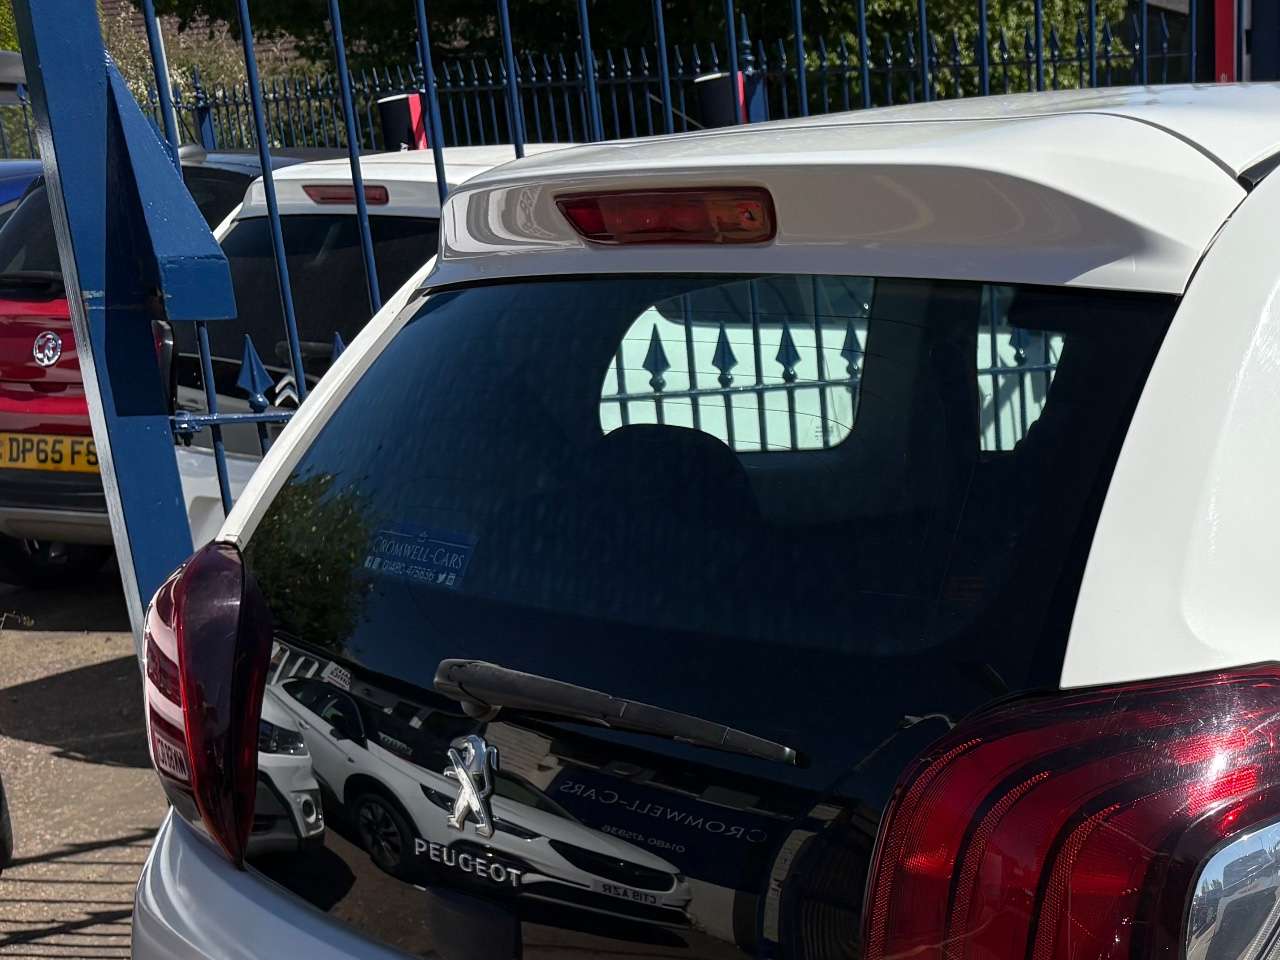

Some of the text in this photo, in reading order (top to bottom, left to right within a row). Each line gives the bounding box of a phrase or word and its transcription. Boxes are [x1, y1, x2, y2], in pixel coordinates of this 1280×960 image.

[8, 436, 98, 466] DP65 FS
[415, 838, 521, 887] PEUGEOT
